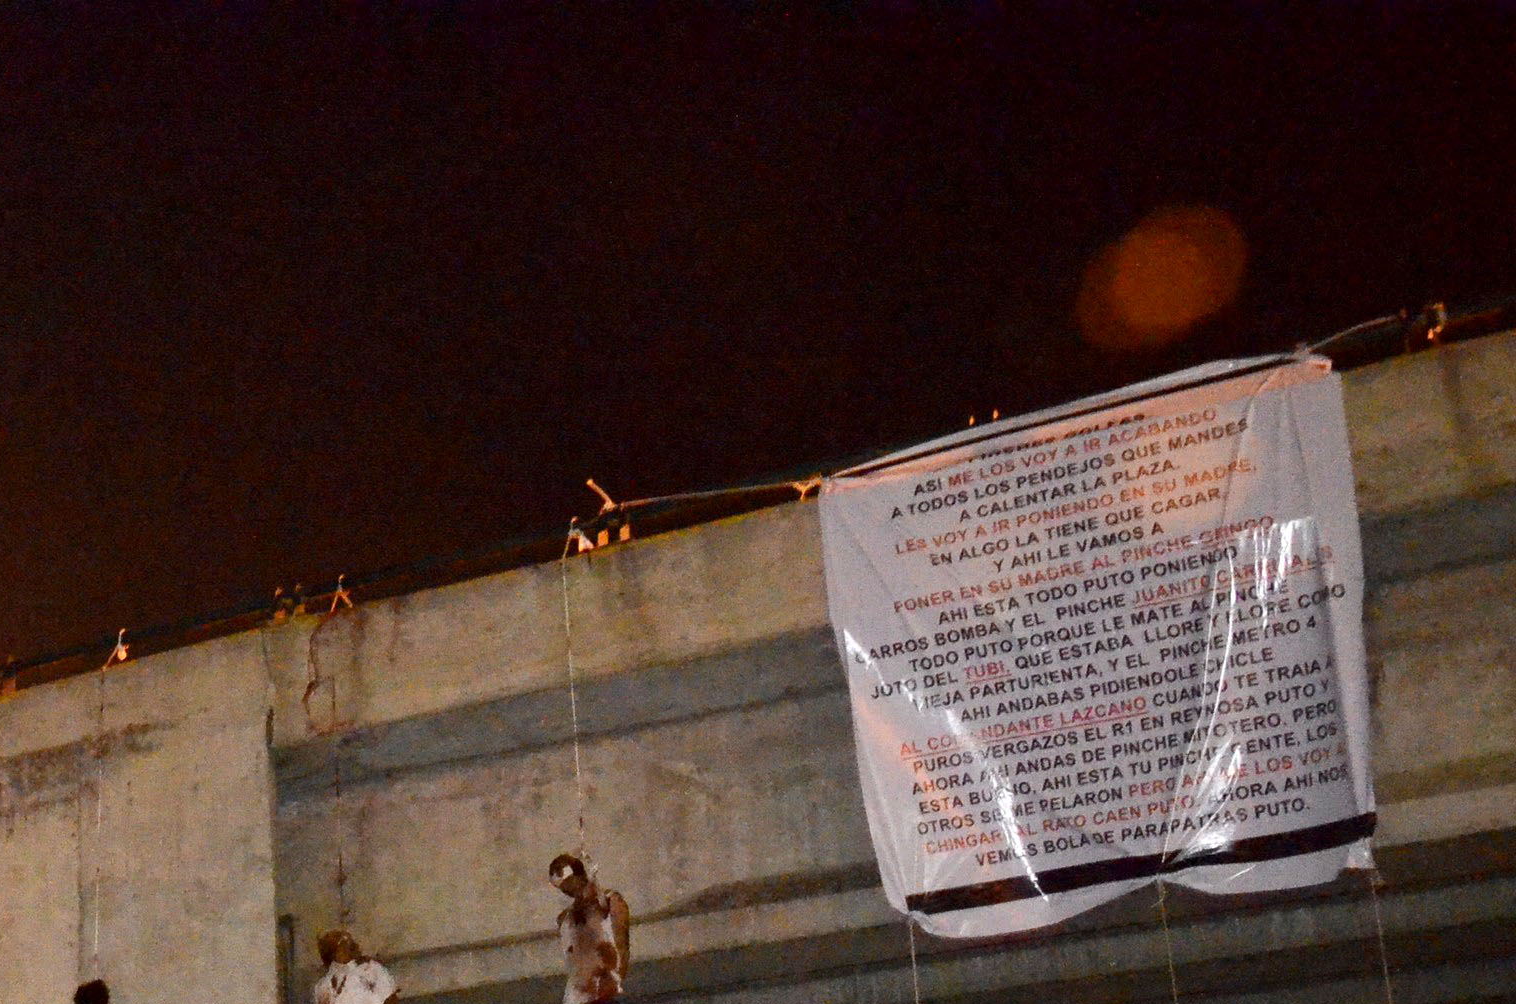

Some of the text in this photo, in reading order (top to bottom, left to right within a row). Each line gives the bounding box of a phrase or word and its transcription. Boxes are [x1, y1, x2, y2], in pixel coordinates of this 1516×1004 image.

[890, 506, 902, 520] A
[908, 489, 968, 515] TODOS
[974, 478, 1010, 499] LOS
[1016, 452, 1114, 488] PENDEJOS
[1120, 440, 1161, 462] QUE
[1168, 418, 1248, 451] MANDES
[913, 407, 1216, 496] ASI ME LOS VOY A IR ACABANDO
[894, 536, 927, 555] LES
[932, 526, 968, 547] VOY
[973, 522, 987, 537] A
[991, 516, 1010, 533] IR
[1015, 491, 1114, 527] PONIENDO
[1118, 483, 1145, 503] EN
[1151, 475, 1176, 495] SU
[930, 550, 952, 567] EN
[958, 537, 1009, 560] ALGO
[1015, 530, 1039, 547] LA
[1044, 516, 1098, 540] TIENE
[1104, 505, 1144, 526] QUE
[958, 508, 970, 522] A
[976, 482, 1075, 518] CALENTAR
[1081, 474, 1105, 492] LA
[893, 515, 1274, 614] PONER EN SU MADRE AL PINCHE GRINGO
[937, 544, 1237, 625] AHI ESTA TODO PUTO PONIENDO
[993, 520, 1164, 572] Y AHI LE VAMOS A
[908, 650, 958, 673] TODO
[963, 638, 1012, 661] PUTO
[1018, 621, 1095, 650] PORQUE
[1101, 614, 1124, 632] LE
[1130, 602, 1182, 626] MATE
[1188, 596, 1210, 613] AL
[933, 620, 999, 647] BOMBA
[1004, 616, 1017, 632] Y
[1022, 609, 1045, 628] EL
[1055, 591, 1125, 620] PINCHE
[1133, 572, 1211, 604] JUANITO
[869, 678, 917, 700] JOTO
[922, 669, 958, 689] DEL
[1014, 649, 1052, 670] QUE
[1058, 631, 1133, 661] ESTABA
[1143, 616, 1204, 643] LLORE
[1205, 613, 1218, 630] Y
[912, 689, 963, 712] VIEJA
[1107, 656, 1120, 672] Y
[1125, 649, 1149, 668] EL
[1159, 632, 1230, 661] PINCHE
[1232, 617, 1300, 646] METRO
[1305, 613, 1316, 631] 4
[960, 646, 1273, 723] AHI ANDABAS PIDIENDOLE CHICLE
[898, 739, 921, 756] AL
[927, 713, 1054, 750] CONDANTE
[1059, 694, 1146, 724] LAZCANO
[1152, 678, 1228, 706] CUANDO
[1234, 672, 1258, 689] TE
[1264, 659, 1320, 683] TRAIA
[911, 771, 973, 796] AHORA
[1014, 751, 1076, 776] ANDAS
[1081, 745, 1106, 763] DE
[1111, 731, 1178, 757] PINCHE
[1292, 699, 1336, 721] PERO
[912, 680, 1329, 774] PUROS VERGAZOS EL R1 EN REYNOSA PUTO Y
[916, 813, 974, 836] OTROS
[1010, 802, 1034, 819] ME
[1039, 786, 1122, 814] PELARON
[1128, 776, 1175, 798] PERO
[1180, 769, 1215, 788] AH
[1254, 754, 1293, 775] LOS
[1299, 747, 1332, 767] VOY
[918, 794, 963, 815] ESTA
[968, 780, 1036, 805] BUO,
[1041, 774, 1070, 792] AHI
[1076, 764, 1123, 786] ESTA
[1129, 758, 1151, 776] TU
[1157, 745, 1221, 771] PINCH
[1306, 723, 1337, 743] LOS
[1042, 813, 1086, 834] RATO
[1092, 803, 1141, 825] CAEN
[1282, 772, 1312, 791] AHI
[1318, 765, 1348, 784] NOS
[1042, 834, 1090, 855] BOLA
[1120, 807, 1247, 842] PARAPATRAS
[1253, 796, 1309, 819] PUTO.
